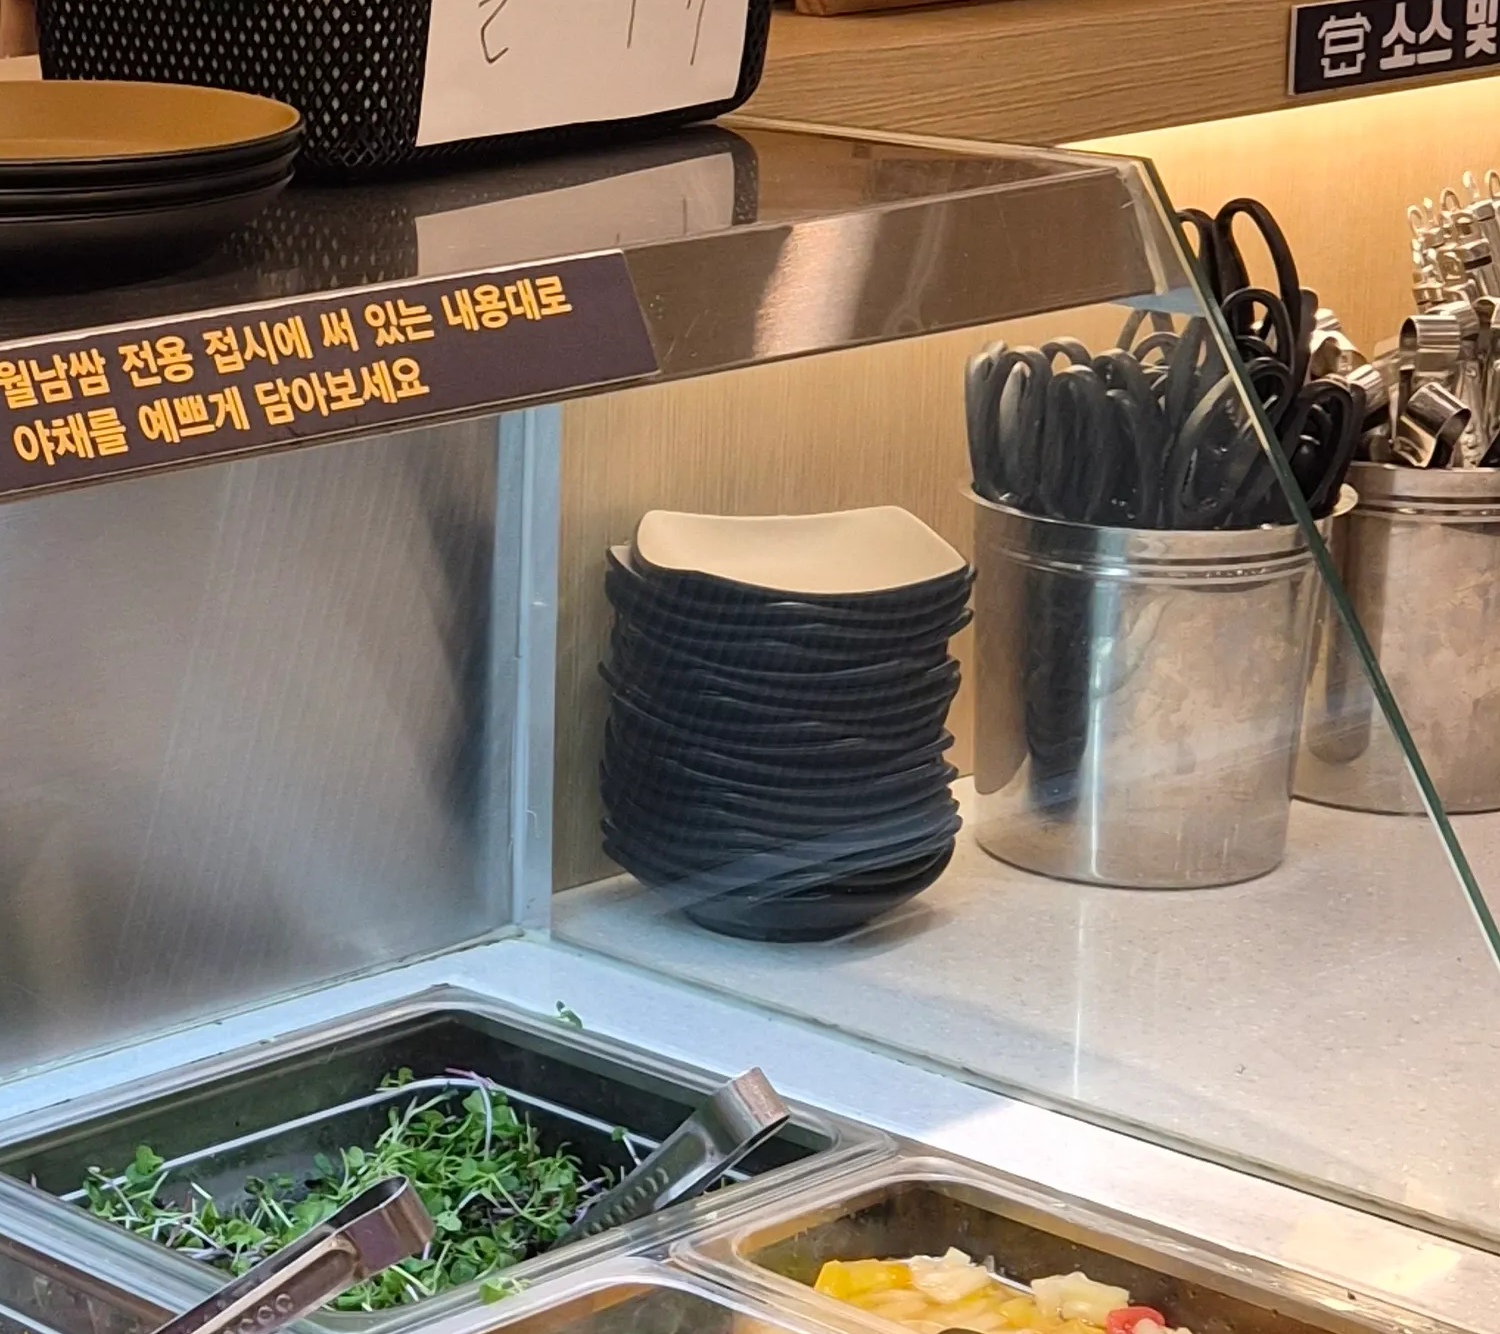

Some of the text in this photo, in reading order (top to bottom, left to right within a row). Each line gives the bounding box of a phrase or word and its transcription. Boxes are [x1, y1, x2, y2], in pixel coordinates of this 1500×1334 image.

[119, 336, 194, 389] 전용
[203, 314, 313, 375] 접시에
[321, 310, 360, 353] 써
[365, 299, 436, 348] 있는
[441, 275, 573, 332] 내용대로
[13, 358, 431, 466] 야채를 예쁘게 담아보세요
